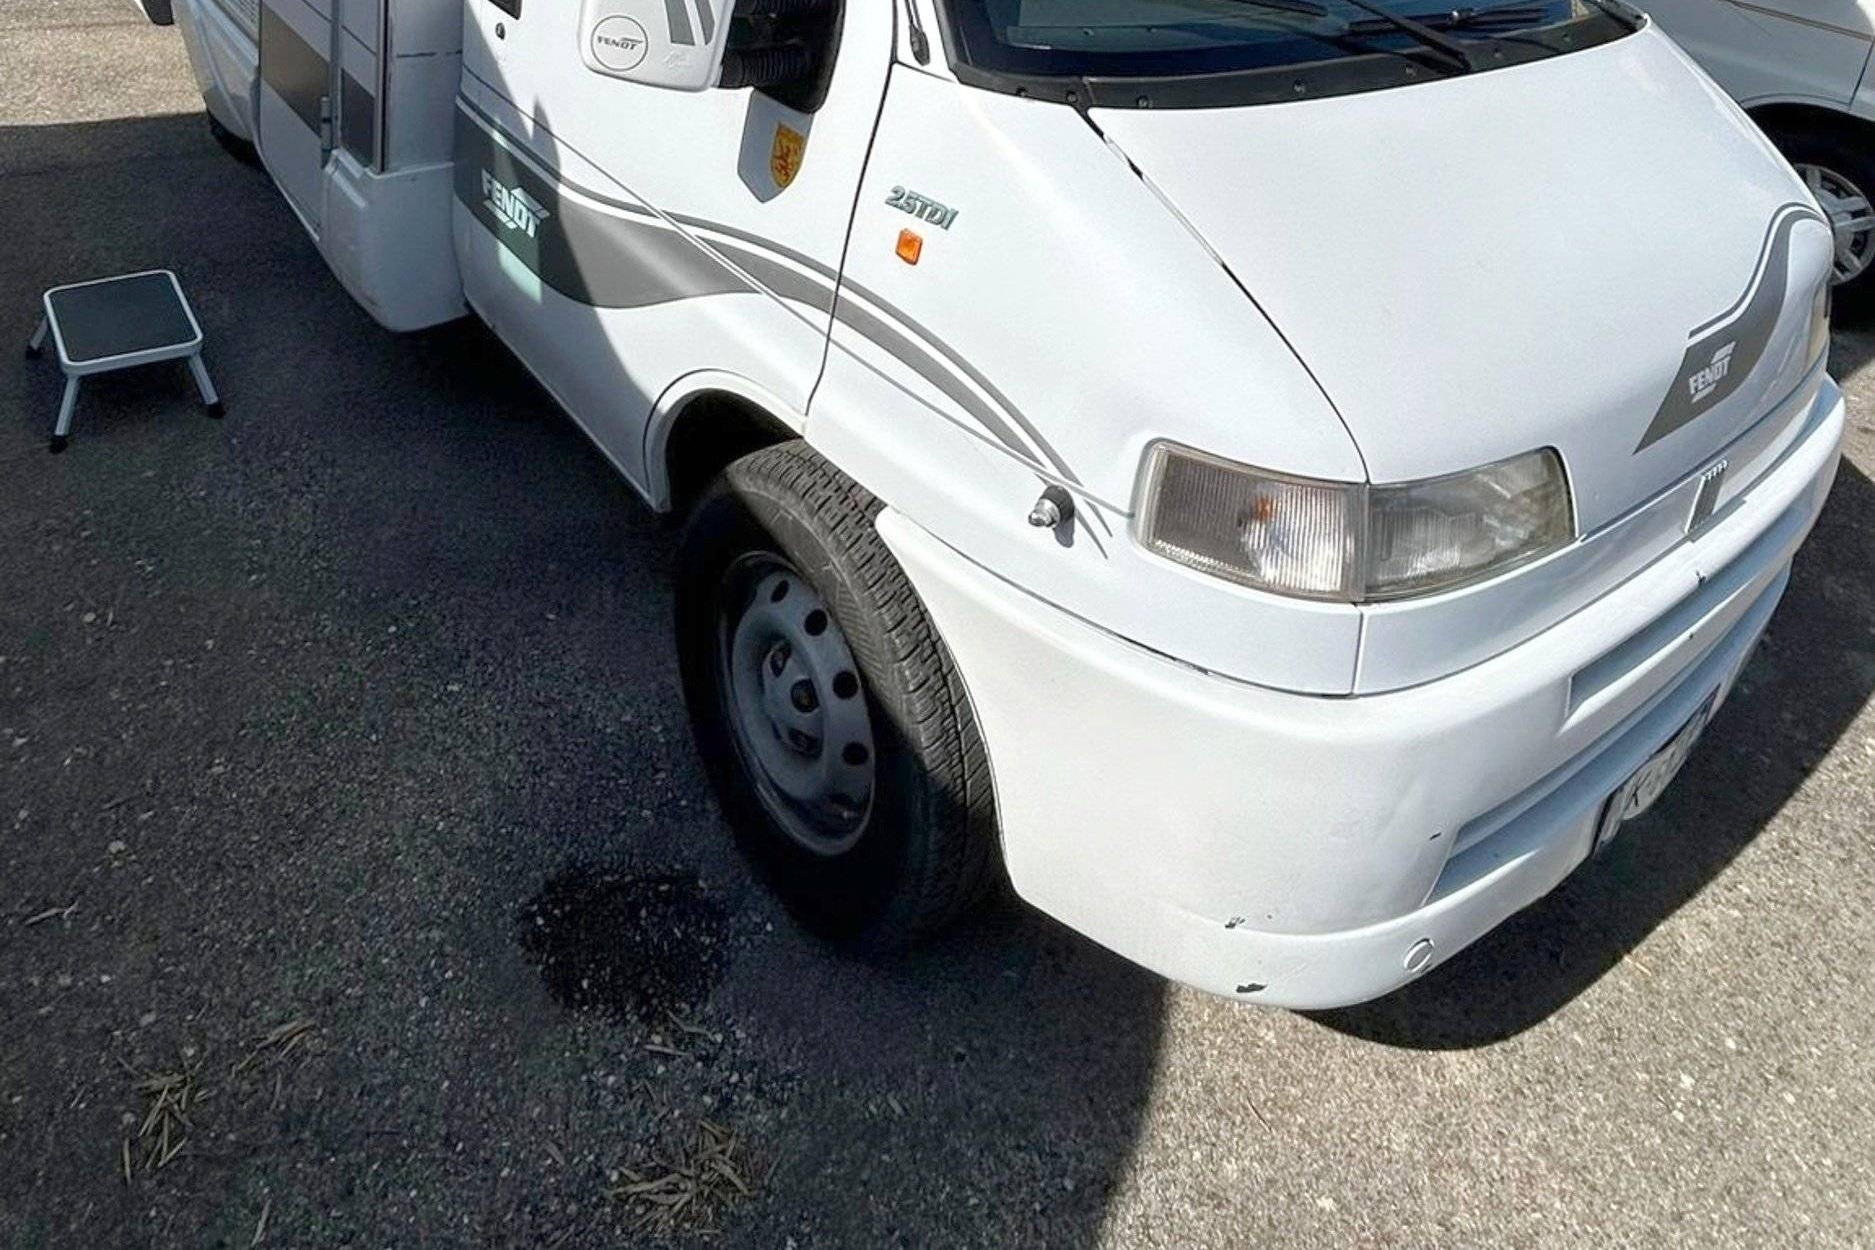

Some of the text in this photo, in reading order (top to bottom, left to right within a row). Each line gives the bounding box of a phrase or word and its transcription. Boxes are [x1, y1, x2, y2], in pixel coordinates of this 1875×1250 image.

[597, 35, 639, 51] FENDT
[480, 168, 541, 238] FENDT
[1688, 354, 1731, 395] FENDT
